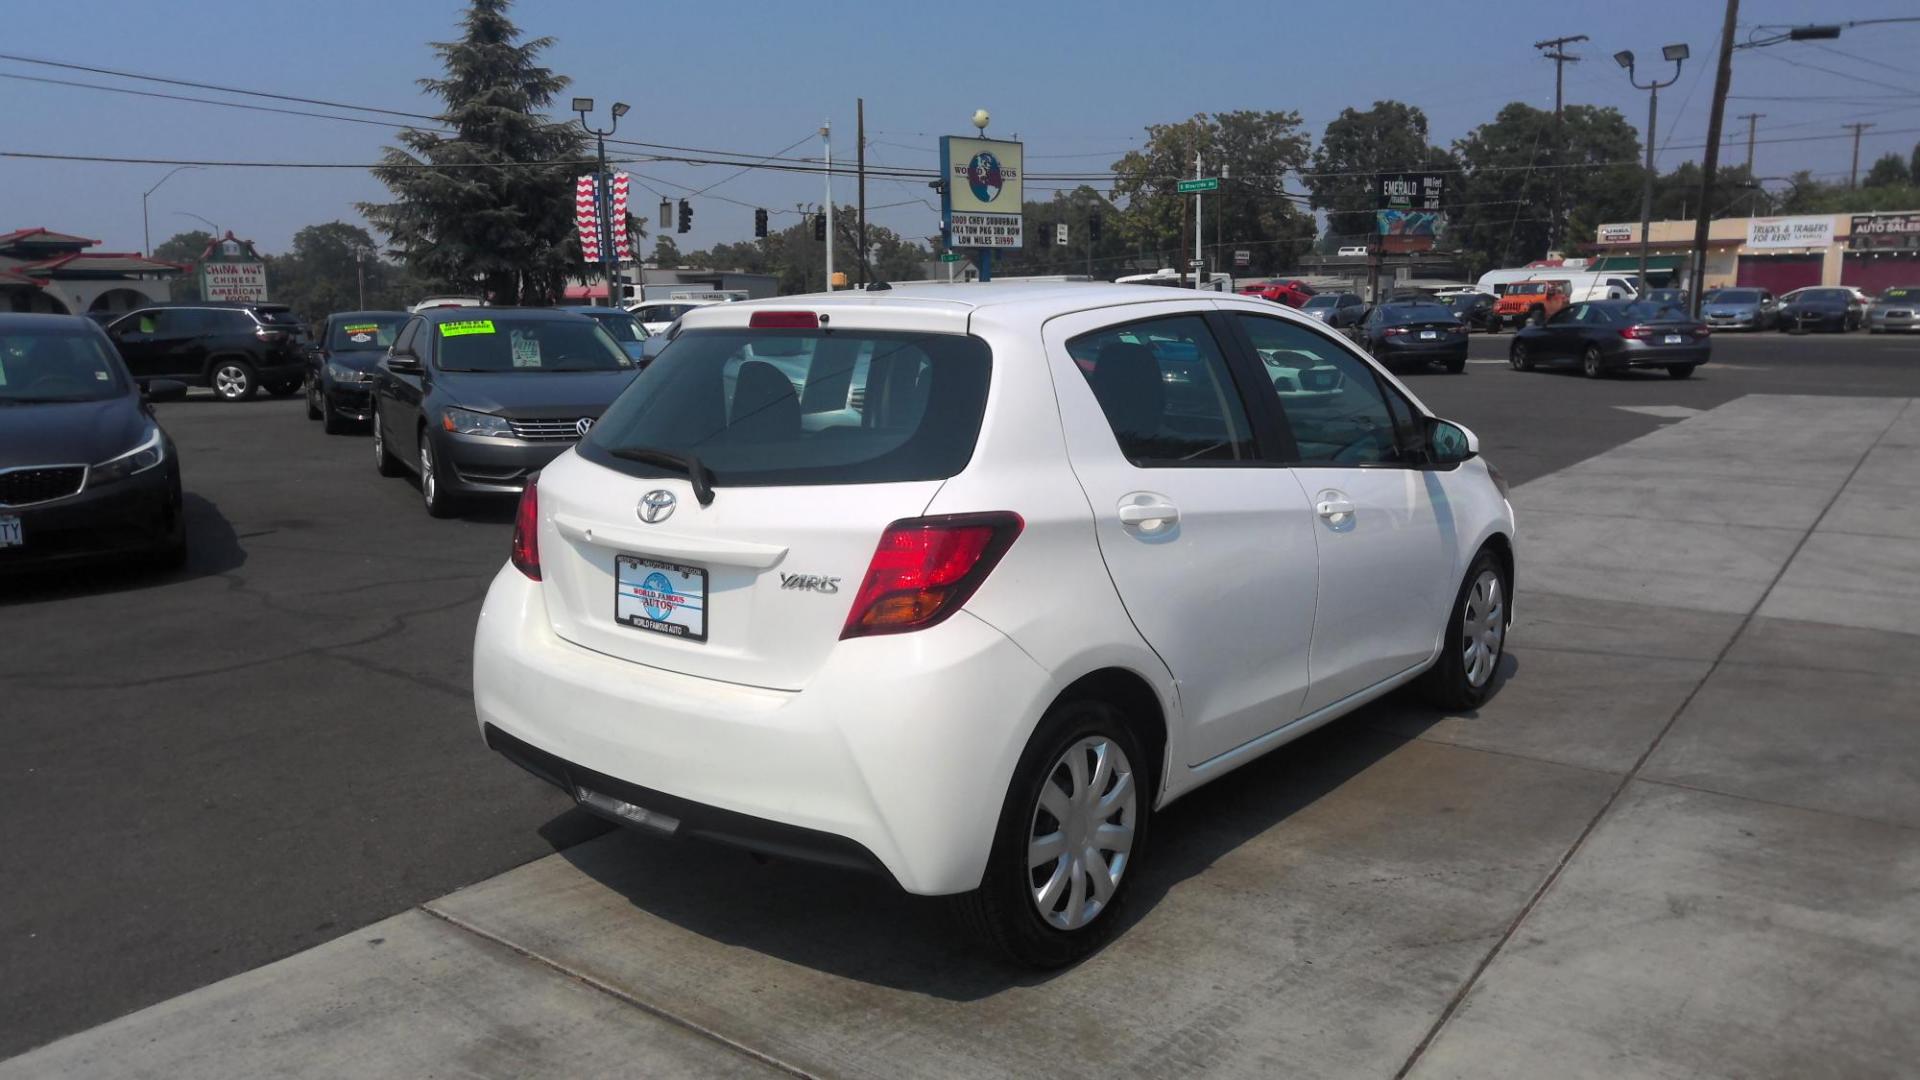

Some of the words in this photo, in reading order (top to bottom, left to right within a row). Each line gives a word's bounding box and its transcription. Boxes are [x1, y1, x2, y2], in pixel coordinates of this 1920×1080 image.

[1383, 181, 1417, 196] EMERALD
[968, 216, 985, 225] CHEV
[986, 216, 1019, 226] SUBURBAN
[952, 226, 964, 235] 4X4
[965, 226, 978, 235] TOW
[979, 226, 992, 235] PKG
[993, 227, 1005, 235] 3RD
[1007, 227, 1020, 236] ROW
[1753, 225, 1781, 234] TRUCKS
[1783, 225, 1790, 233] &
[1793, 223, 1829, 233] TRAILERS
[1855, 222, 1885, 234] AUTO
[958, 236, 971, 245] LOW
[973, 236, 992, 245] MILES
[1753, 233, 1769, 243] FOR
[1771, 233, 1791, 242] RENT
[206, 264, 239, 275] CHINA
[242, 264, 263, 275] HUT
[213, 276, 257, 284] CHINESE
[211, 288, 262, 296] AMERICAN
[779, 571, 842, 594] YARIS
[633, 587, 655, 599] WORLD
[657, 591, 685, 604] FAMOUS
[642, 598, 674, 611] AUTOS
[633, 617, 650, 629] WORLD
[649, 620, 669, 633] FAMOUS
[669, 624, 683, 636] AUTO
